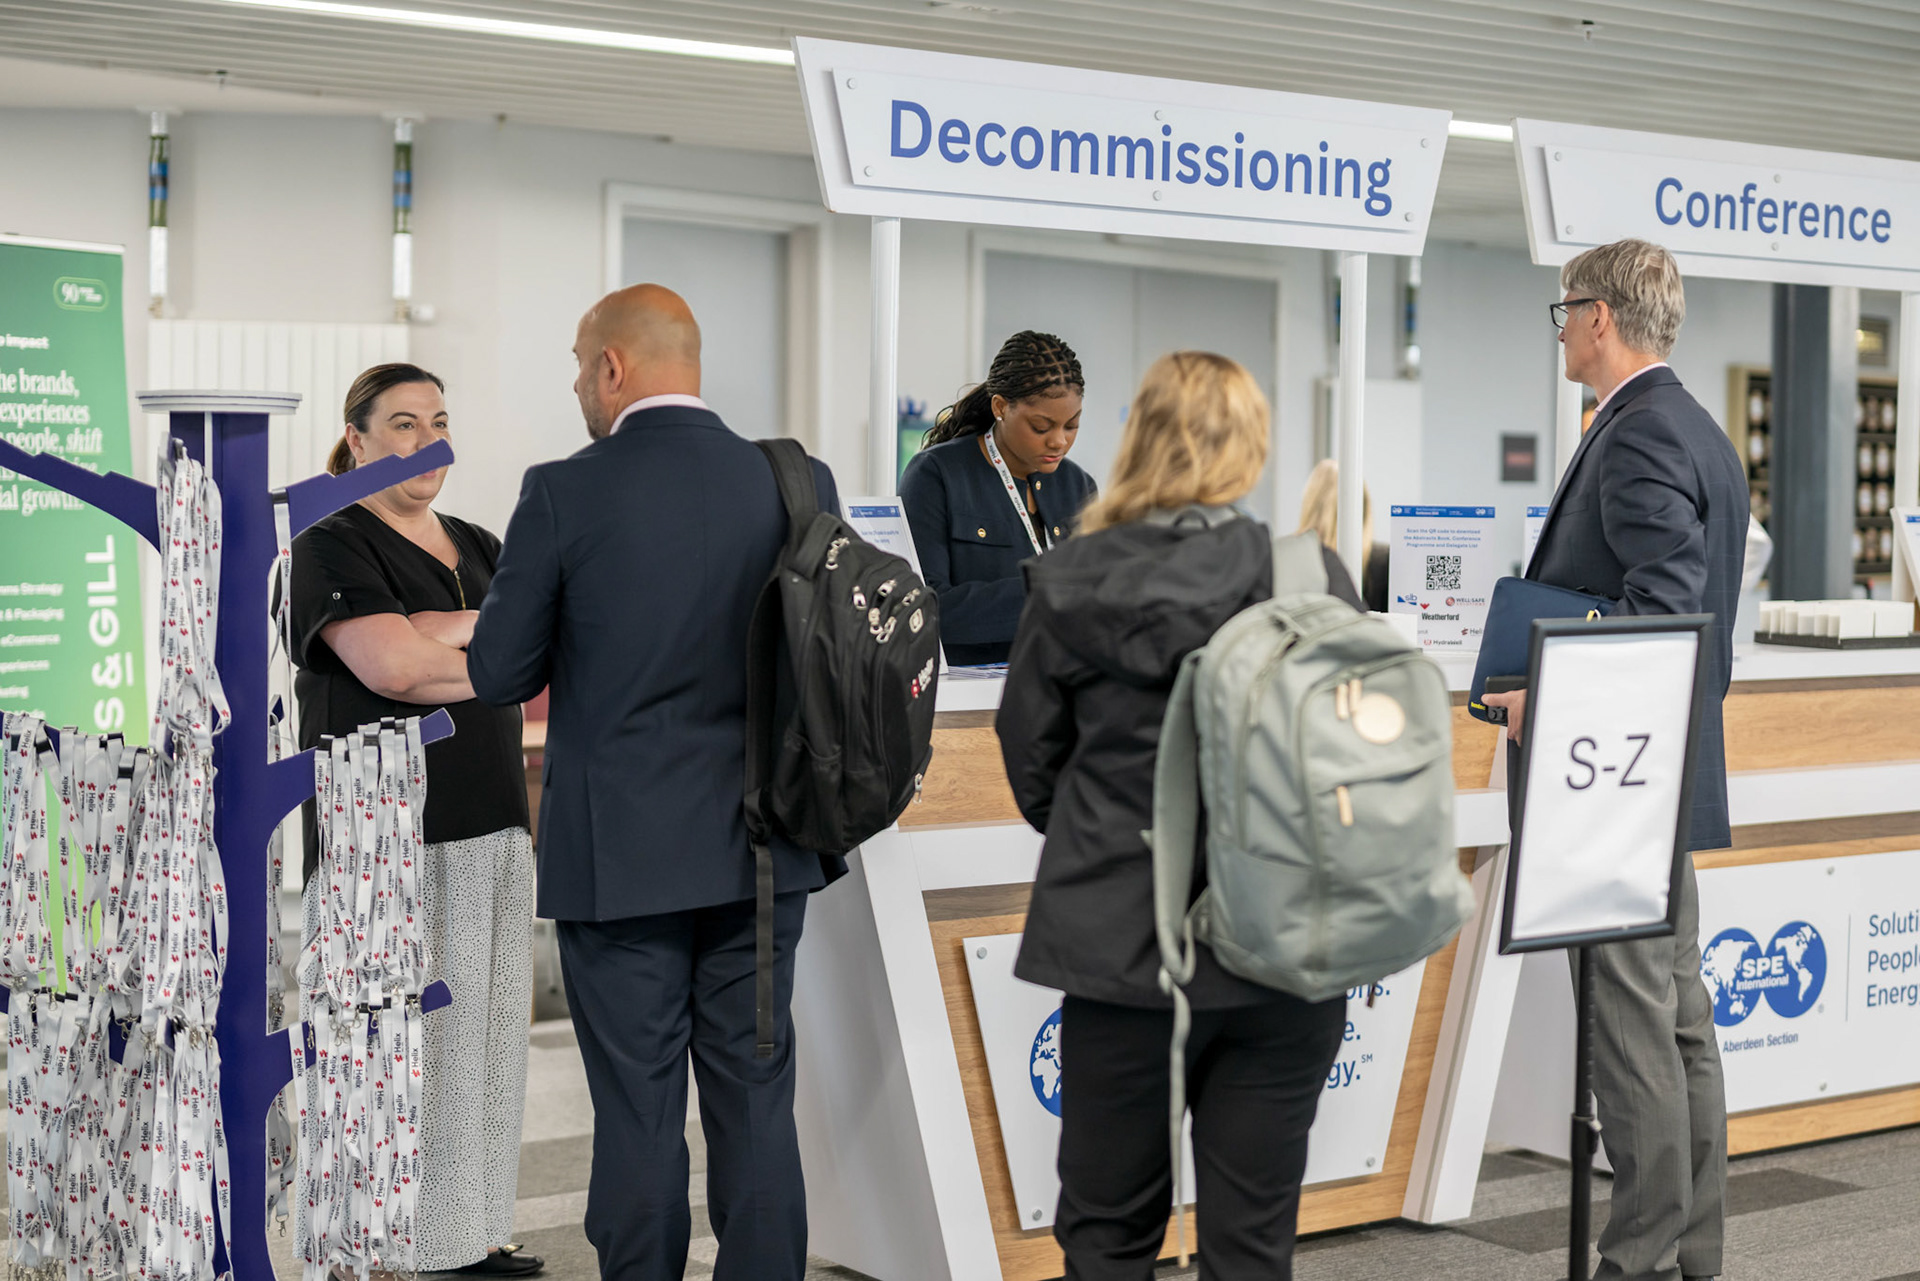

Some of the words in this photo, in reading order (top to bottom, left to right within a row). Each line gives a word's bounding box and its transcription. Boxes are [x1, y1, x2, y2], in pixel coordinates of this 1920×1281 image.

[890, 99, 1392, 217] Decommissioning
[1655, 177, 1891, 243] Conference
[19, 368, 80, 399] brands,
[0, 398, 91, 428] experiences
[6, 427, 65, 455] people,
[66, 427, 104, 453] shift
[85, 534, 120, 648] GILL
[1405, 593, 1418, 601] slb
[1421, 612, 1460, 621] Weatherford
[22, 730, 32, 749] Helix
[1566, 734, 1651, 790] S-Z
[88, 793, 96, 813] Helix
[107, 793, 115, 812] Helix
[102, 855, 110, 873] Helix
[139, 851, 147, 871] Helix
[363, 852, 371, 871] Helix
[110, 896, 118, 916] Helix
[130, 891, 139, 910] Helix
[336, 893, 345, 911] Helix
[18, 912, 28, 931] Helix
[357, 913, 365, 932] Helix
[120, 929, 130, 946] Helix
[127, 936, 139, 955] Helix
[149, 943, 157, 963] Helix
[1867, 945, 1920, 976] Peopl
[1741, 955, 1786, 980] SPE
[1735, 973, 1790, 993] International
[1865, 984, 1920, 1009] Energ
[1722, 1035, 1765, 1053] Aberdeen
[1766, 1031, 1799, 1047] Section
[43, 1045, 51, 1065] Helix
[90, 1043, 98, 1062] Helix
[1361, 1053, 1373, 1063] SM
[57, 1056, 66, 1076] Helix
[409, 1105, 417, 1124] Helix
[215, 1129, 223, 1148] Helix
[109, 1169, 118, 1189] Helix
[119, 1161, 129, 1180] Helix
[128, 1174, 136, 1193] Helix
[377, 1178, 385, 1197] Helix
[123, 1229, 132, 1248] Helix
